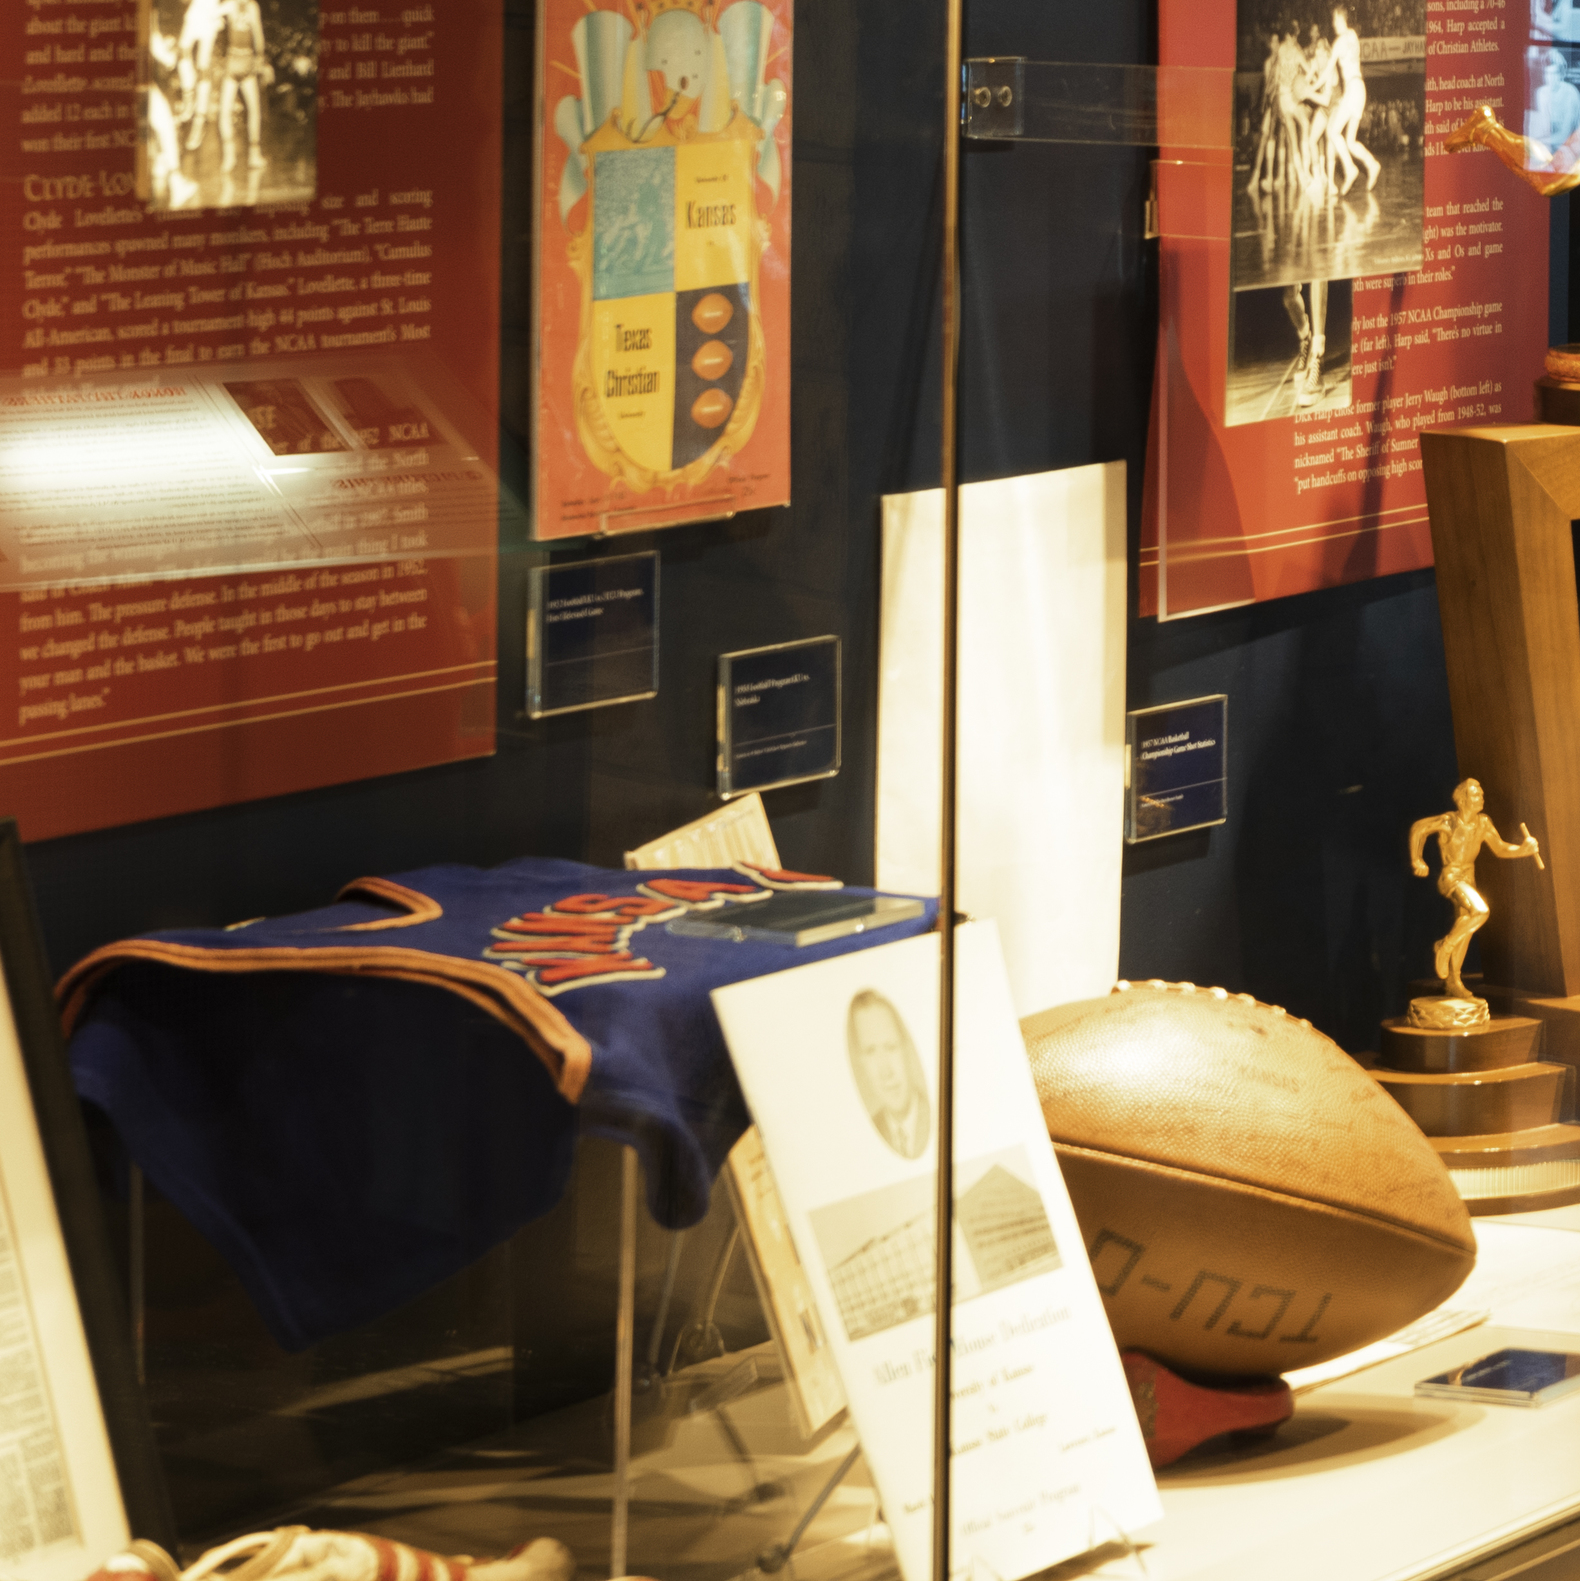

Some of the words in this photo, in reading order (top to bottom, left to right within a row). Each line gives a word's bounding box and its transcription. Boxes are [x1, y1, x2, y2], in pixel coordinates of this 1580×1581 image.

[1360, 41, 1387, 59] CAA
[1427, 40, 1436, 55] of
[1436, 40, 1468, 54] Christian
[1470, 38, 1498, 52] Athletes.
[686, 201, 737, 229] Kansas
[1294, 431, 1305, 446] his
[1308, 429, 1337, 443] assistant
[1340, 422, 1363, 438] coach.
[1363, 418, 1393, 435] Waugh,
[1393, 415, 1410, 429] who
[1412, 411, 1435, 430] played
[1437, 409, 1454, 422] from
[1457, 404, 1485, 419] 1948-52,
[1488, 403, 1501, 413] was
